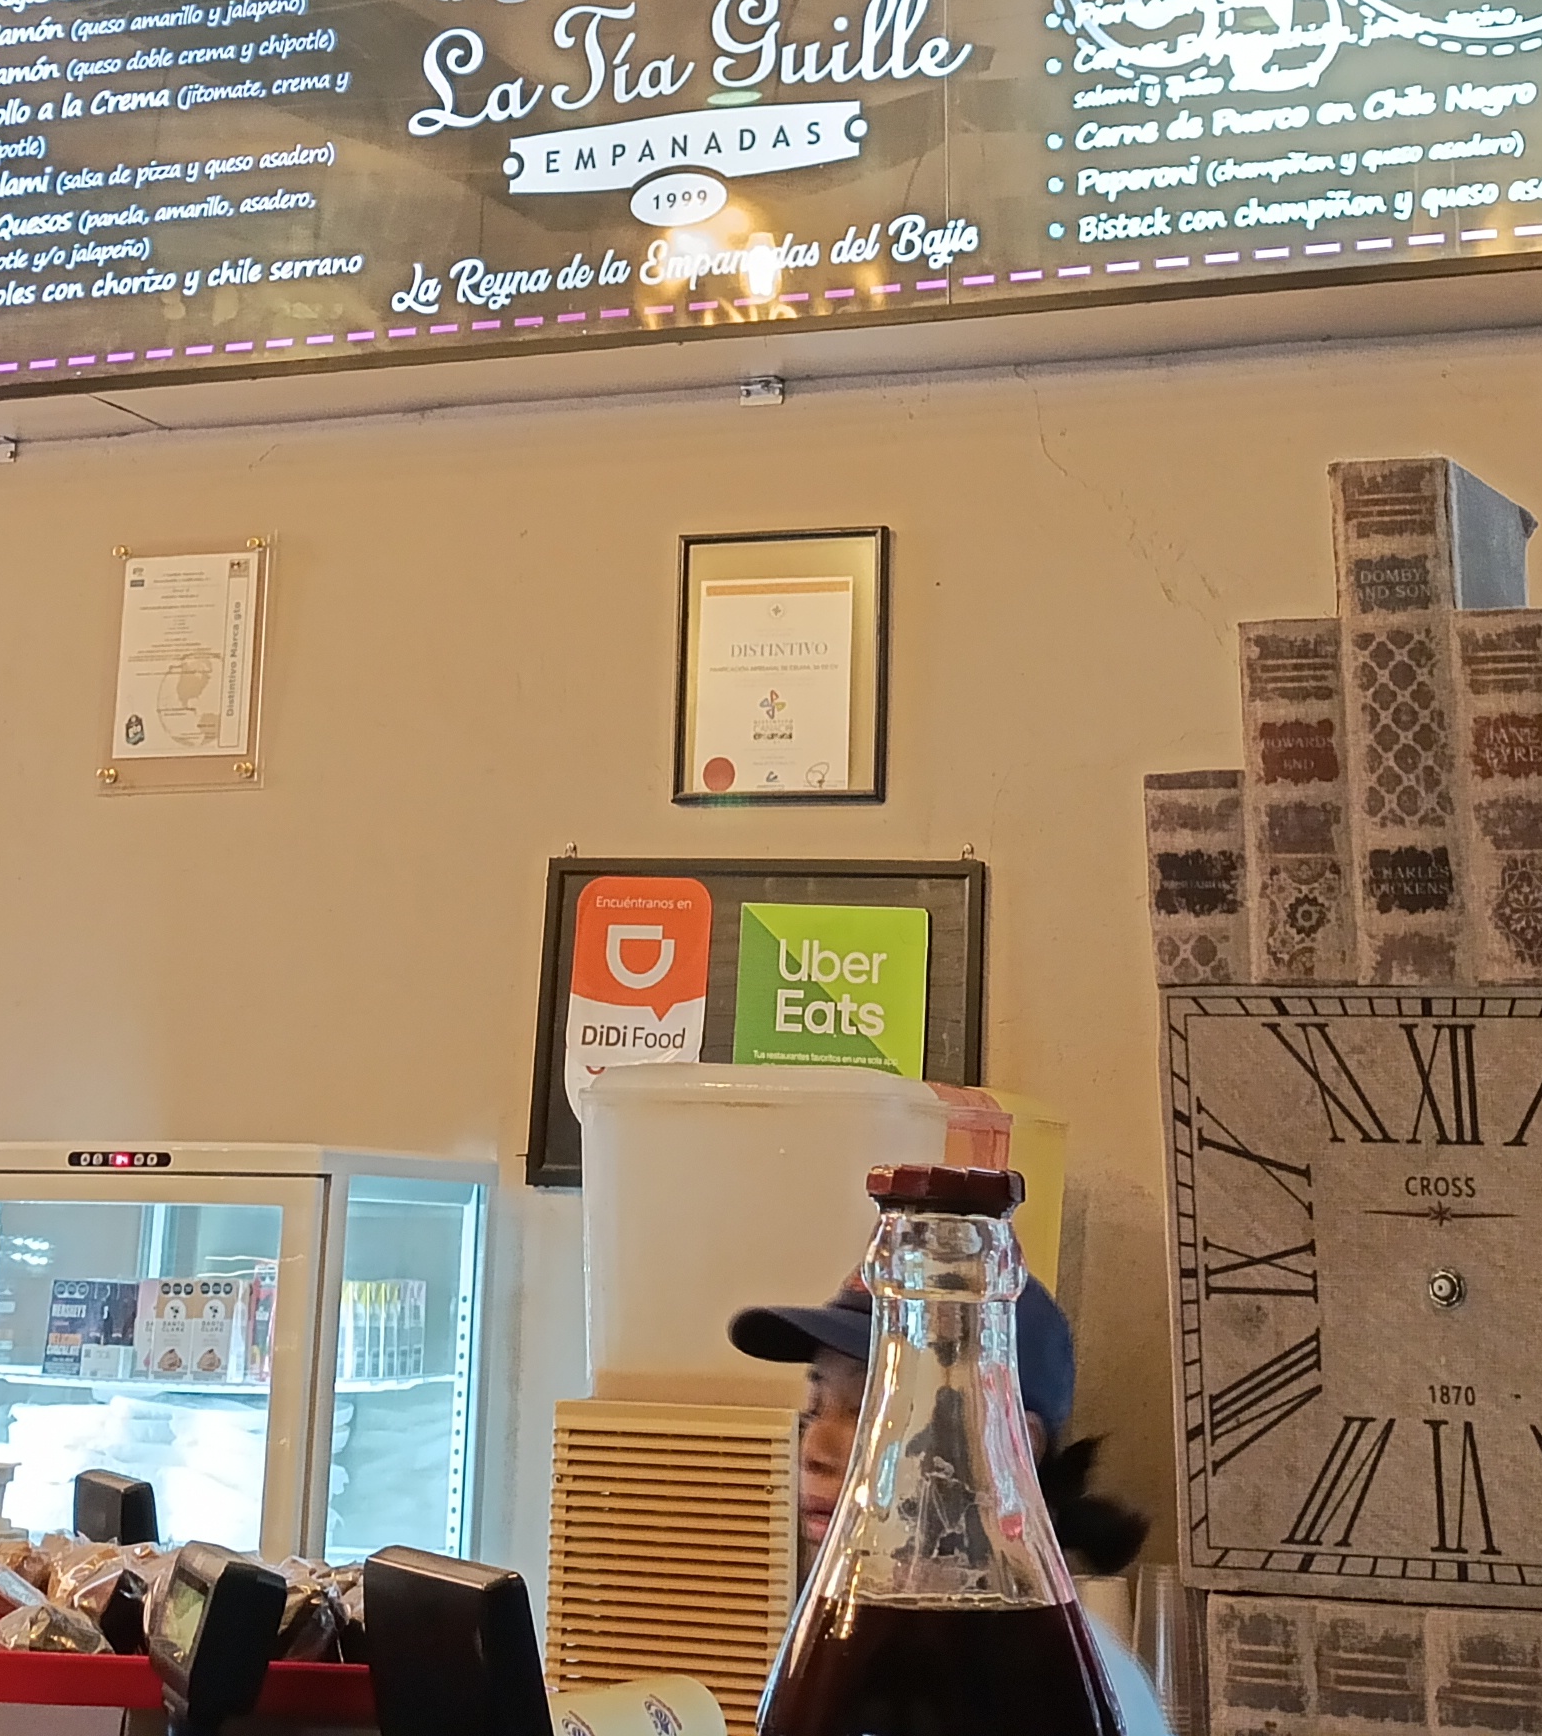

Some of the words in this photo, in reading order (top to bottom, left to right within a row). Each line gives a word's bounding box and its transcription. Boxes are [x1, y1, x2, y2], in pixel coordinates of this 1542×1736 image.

[67, 58, 121, 80] (queso
[126, 51, 172, 69] doble
[178, 45, 235, 63] crema
[240, 43, 253, 61] y
[258, 30, 335, 57] chipotle)
[408, 27, 546, 137] La
[550, 1, 695, 111] Tía
[545, 121, 823, 174] EMPANADAS
[652, 188, 709, 212] 1999
[42, 279, 85, 303] con
[91, 271, 176, 297] chorizo
[183, 270, 200, 294] y
[207, 258, 261, 287] chile
[268, 254, 362, 280] serrano
[391, 262, 440, 314] La
[449, 258, 550, 310] Reyna
[557, 253, 594, 289] de
[599, 248, 631, 285] la
[639, 233, 821, 291] Empandas
[831, 223, 882, 263] del
[229, 624, 240, 658] Marca
[731, 642, 828, 658] DISTINTIVO
[596, 896, 674, 910] Encuéntranos
[676, 899, 692, 910] en
[779, 938, 887, 985] Uber
[775, 989, 885, 1036] Eats
[581, 1024, 628, 1047] DiDi
[632, 1028, 686, 1049] Food
[1404, 1175, 1477, 1198] CROSS
[1427, 1384, 1477, 1406] 1870
